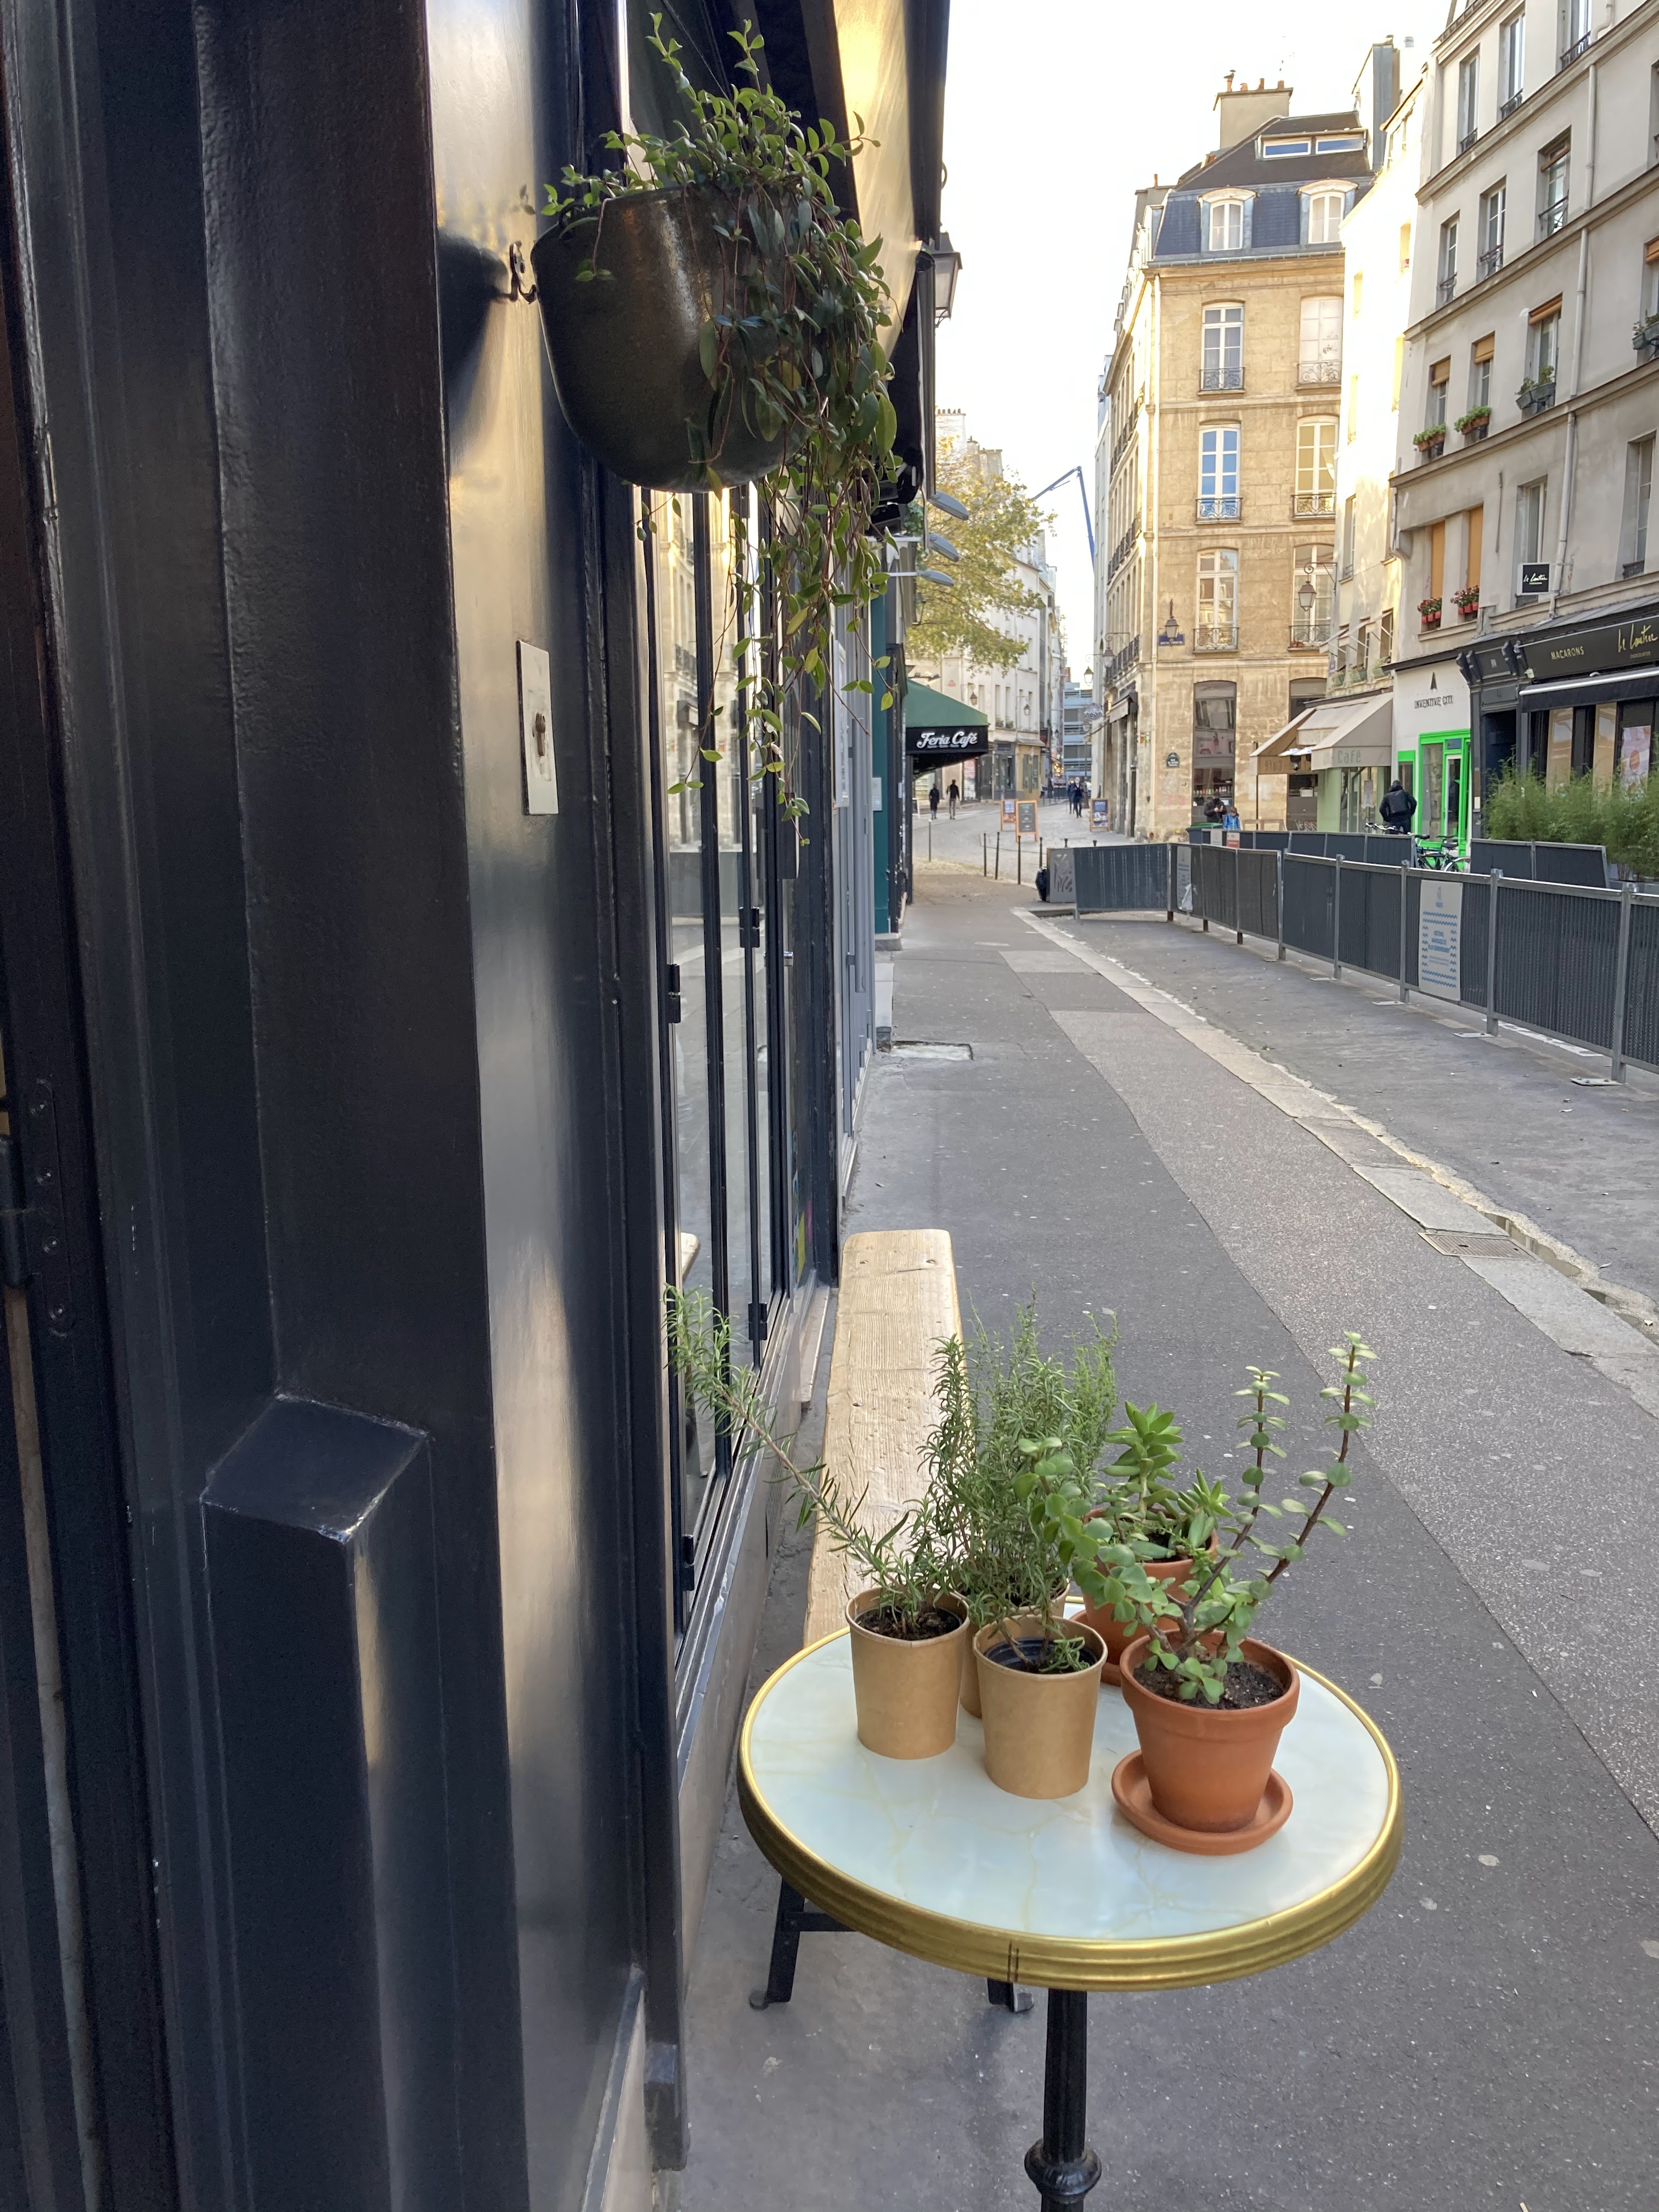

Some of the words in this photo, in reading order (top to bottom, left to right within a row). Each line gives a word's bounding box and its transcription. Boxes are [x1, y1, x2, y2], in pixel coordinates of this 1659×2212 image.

[1550, 646, 1584, 660] MACARONS
[916, 732, 950, 748] Feria
[952, 731, 978, 748] Café
[1338, 749, 1361, 764] Café
